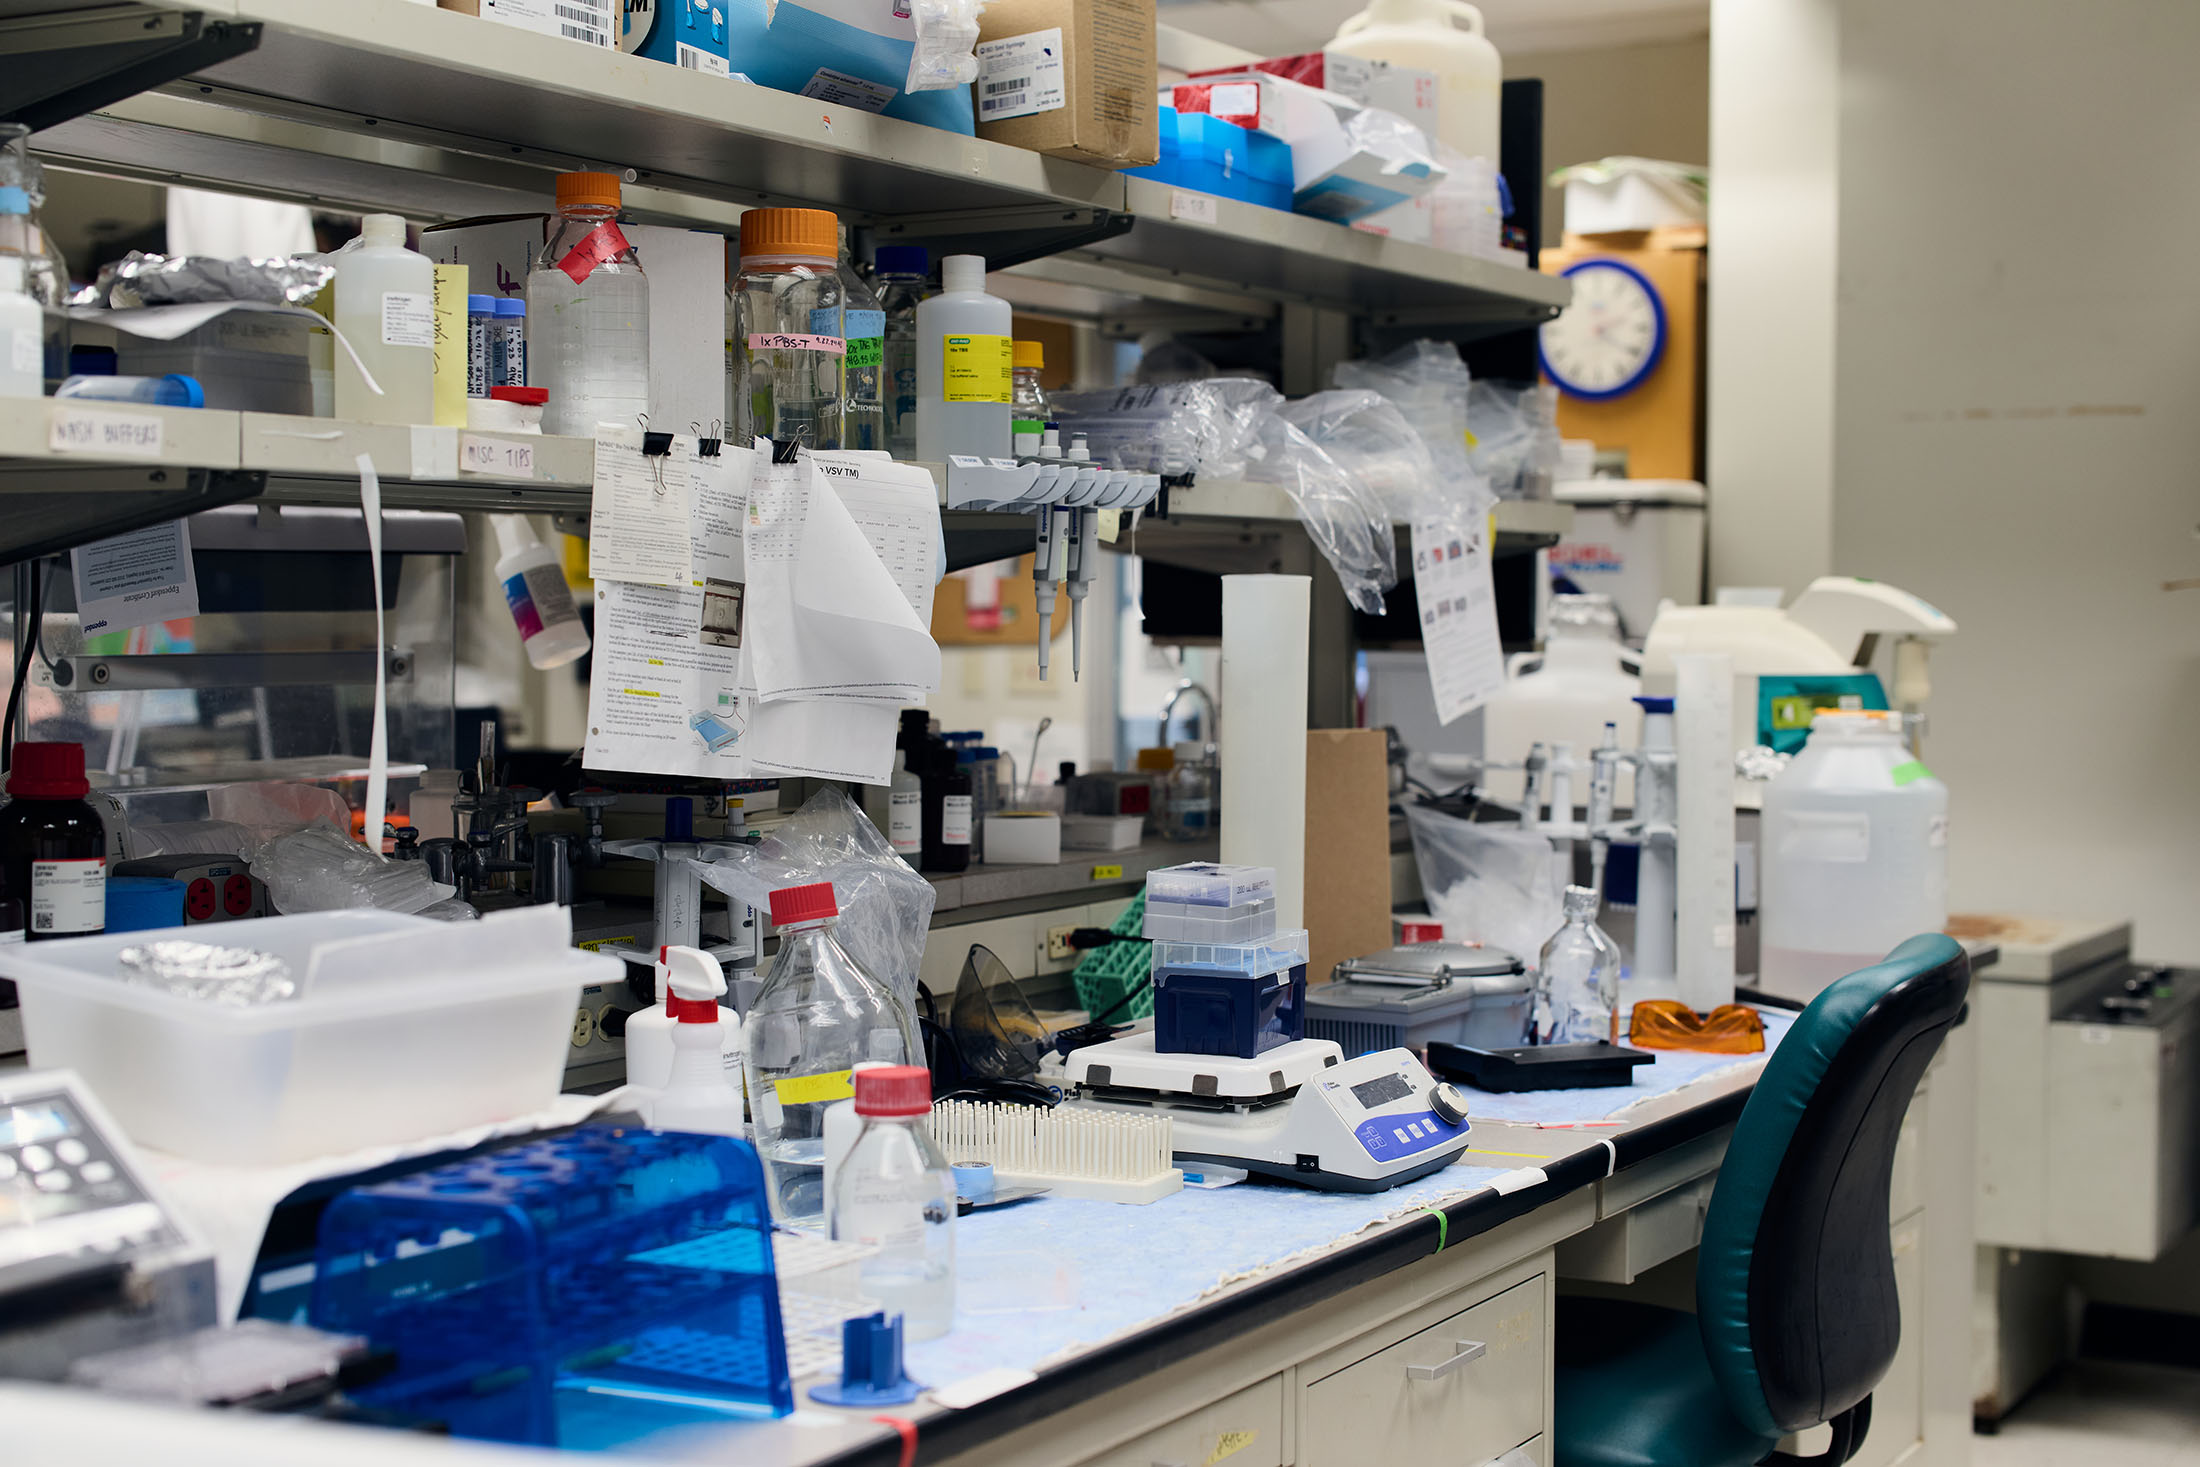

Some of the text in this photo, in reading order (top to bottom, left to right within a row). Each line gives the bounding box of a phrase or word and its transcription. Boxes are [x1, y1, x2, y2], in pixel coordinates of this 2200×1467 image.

[761, 336, 771, 346] 1x
[773, 335, 810, 348] PBS-T
[104, 423, 158, 444] BUFFERS
[468, 446, 531, 468] MISC TIPS
[825, 466, 859, 479] VSV TM)
[123, 585, 180, 604] Eppendorf Certificate
[83, 619, 108, 633] eppendorf
